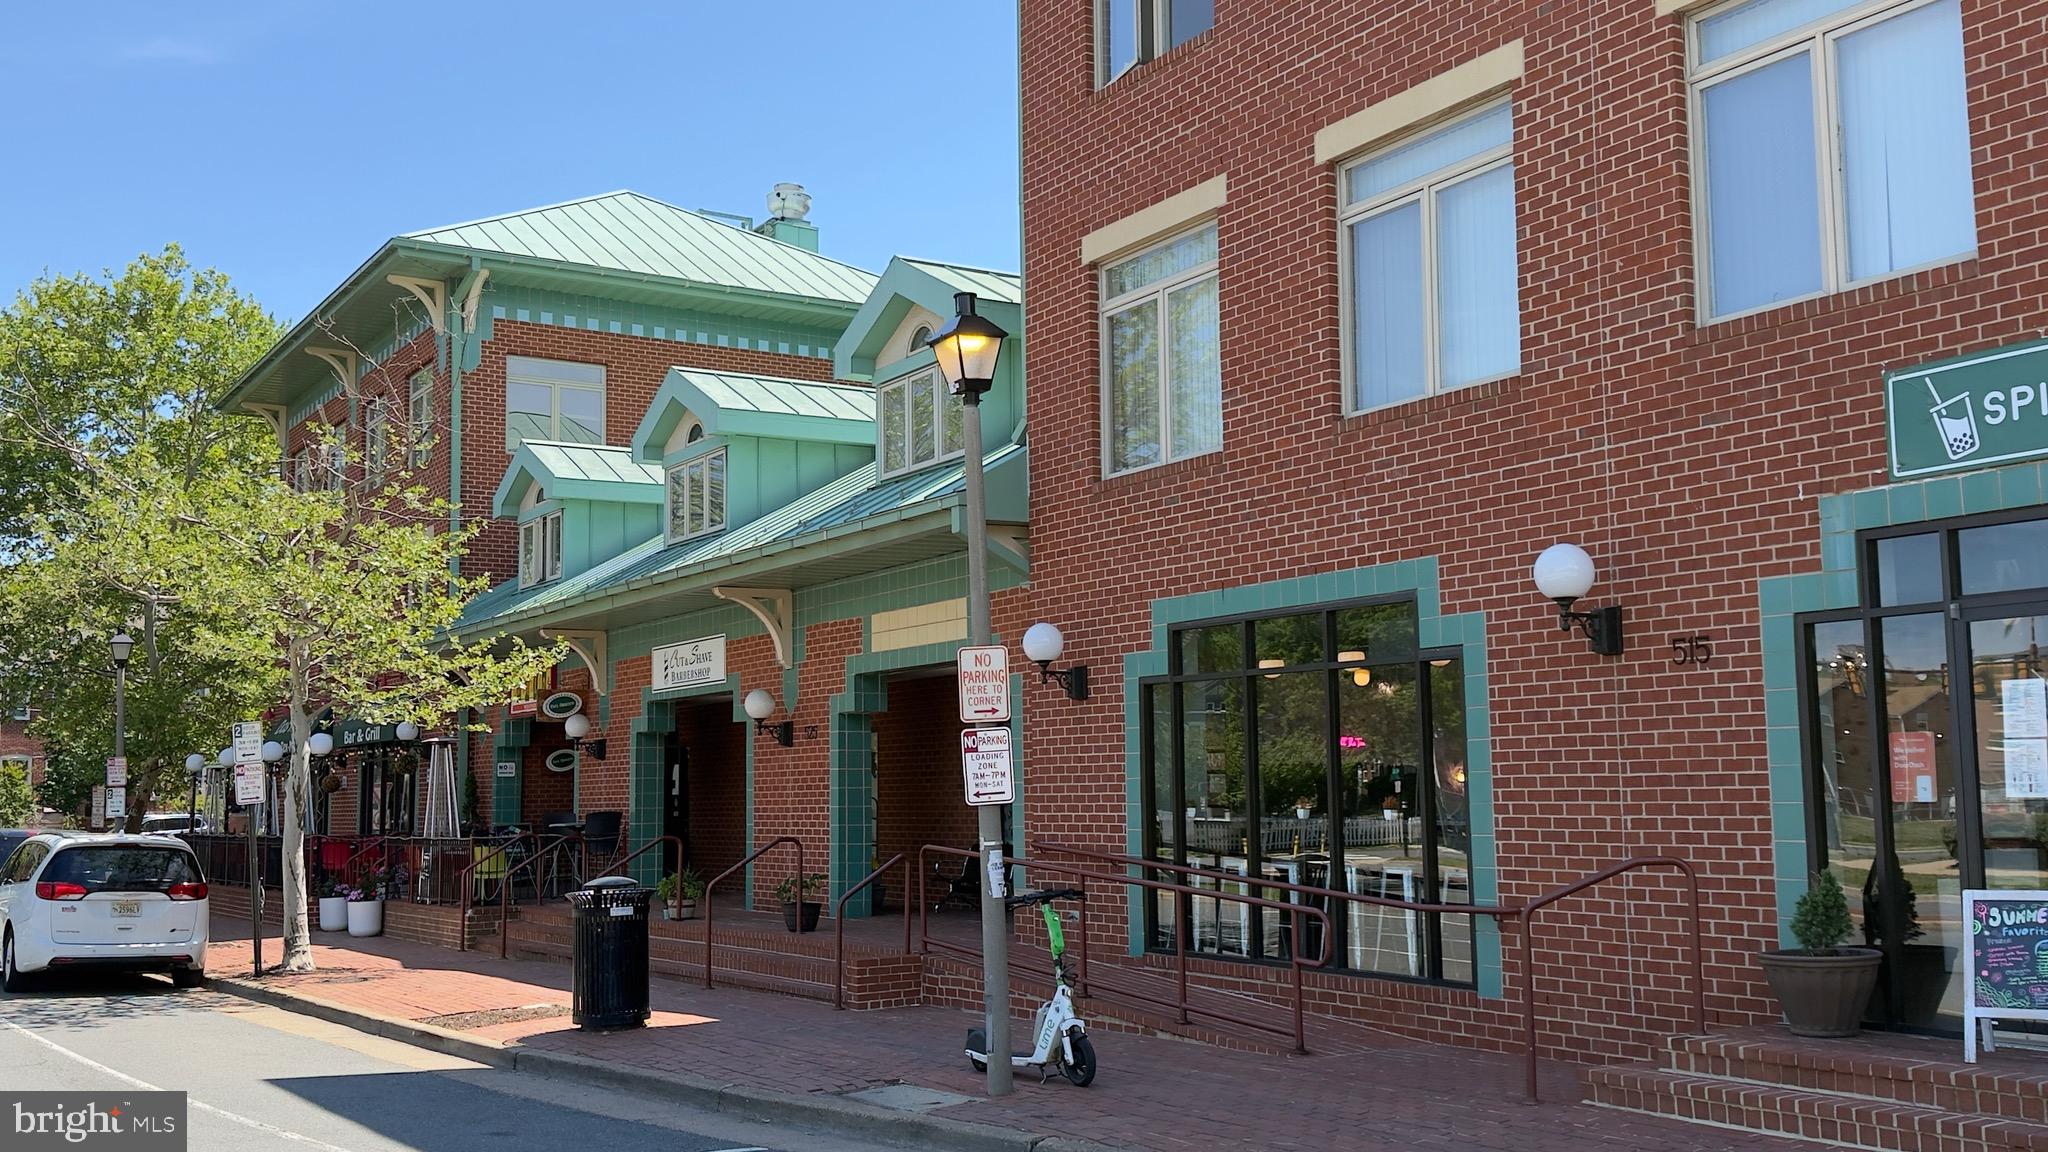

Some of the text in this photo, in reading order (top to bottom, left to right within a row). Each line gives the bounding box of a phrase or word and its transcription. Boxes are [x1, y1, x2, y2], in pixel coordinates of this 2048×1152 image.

[1672, 635, 1711, 666] 515
[974, 653, 992, 668] NO
[671, 667, 711, 682] BARBERSHOP
[962, 669, 1005, 684] PARKING
[966, 684, 1003, 695] HERE TO
[967, 696, 1002, 707] CORNER
[234, 727, 242, 736] 2
[343, 726, 380, 745] Bar & Grill
[964, 734, 1008, 749] NO PARKING
[970, 752, 1005, 761] LOADING
[977, 762, 998, 770] ZONE
[972, 771, 1006, 781] 7AM-7PM
[974, 780, 1004, 789] MON-SAT
[1039, 1018, 1055, 1050] Lime
